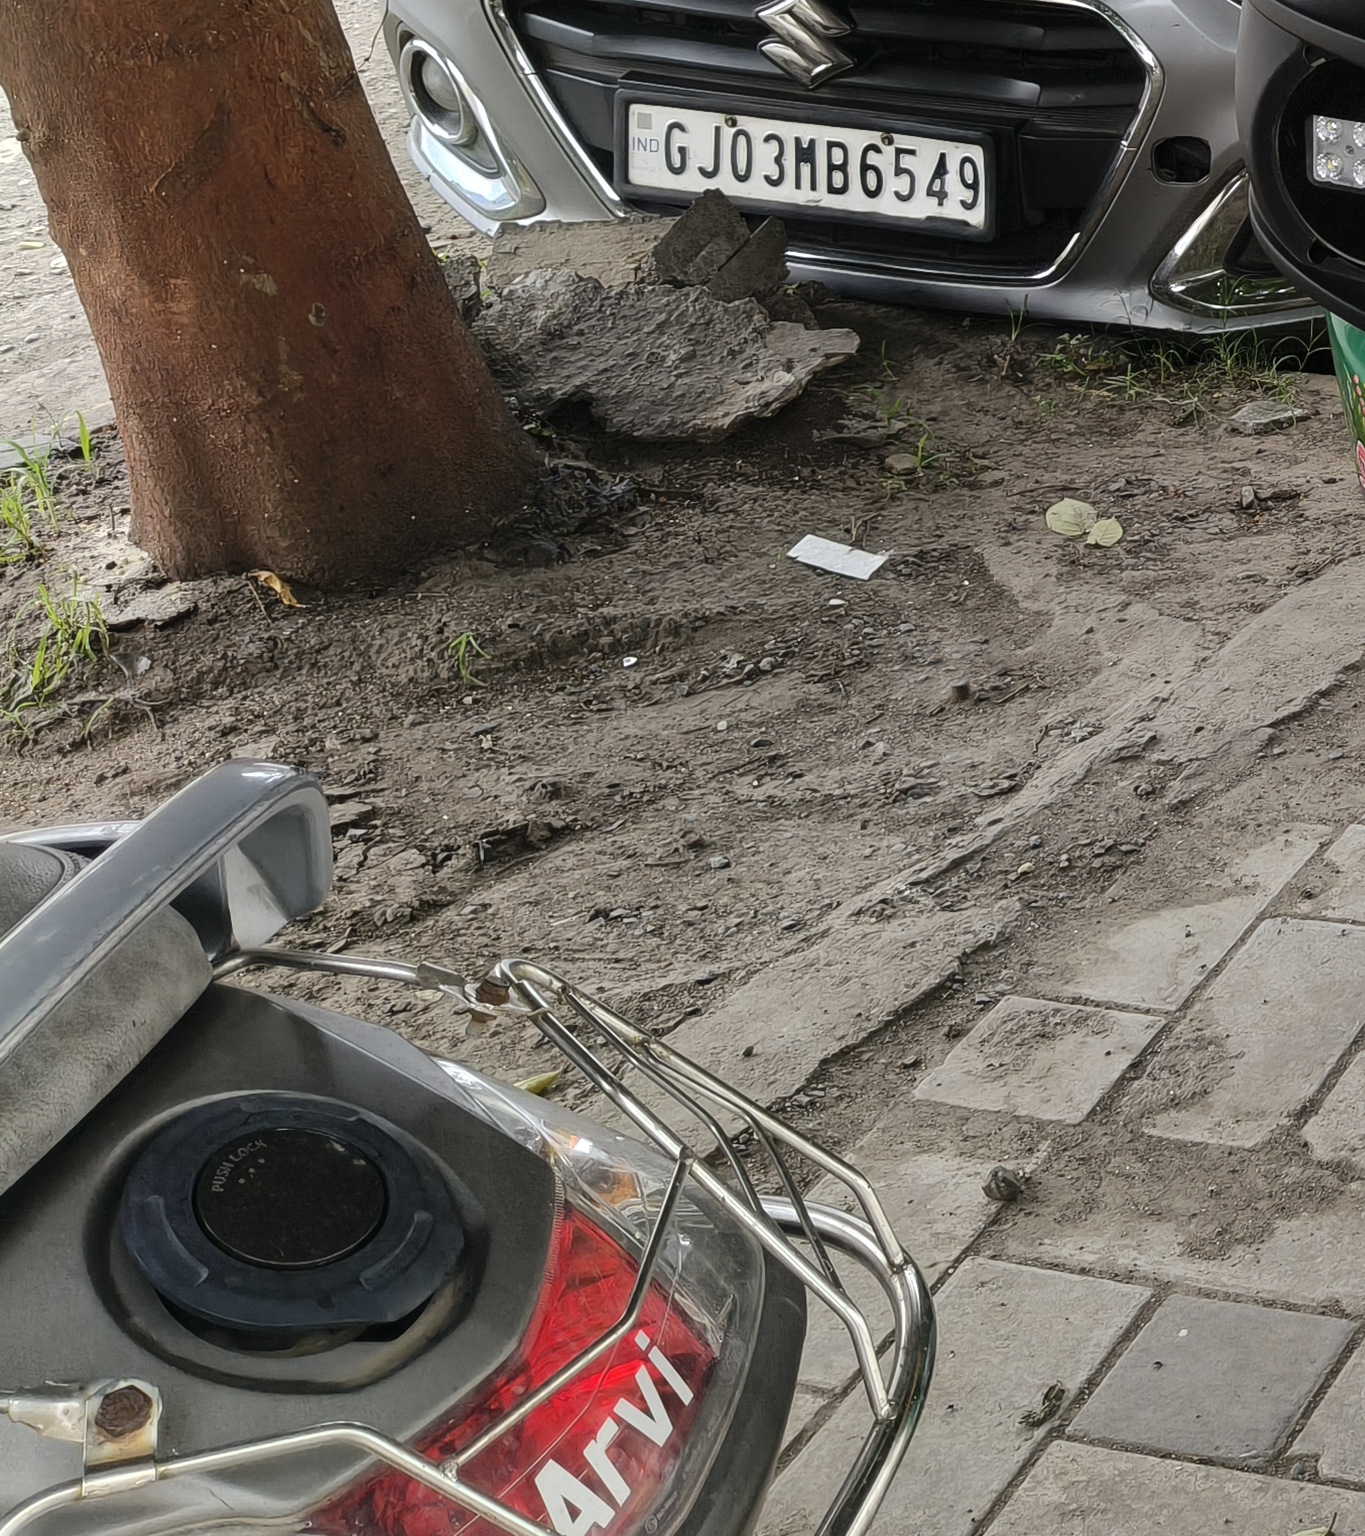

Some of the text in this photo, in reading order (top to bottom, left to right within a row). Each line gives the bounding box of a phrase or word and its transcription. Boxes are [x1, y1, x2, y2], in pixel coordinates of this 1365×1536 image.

[631, 136, 660, 153] IND
[663, 120, 981, 211] GJ03MB6549
[211, 1139, 268, 1193] PUSH LOCK
[534, 1329, 695, 1536] Arvi
